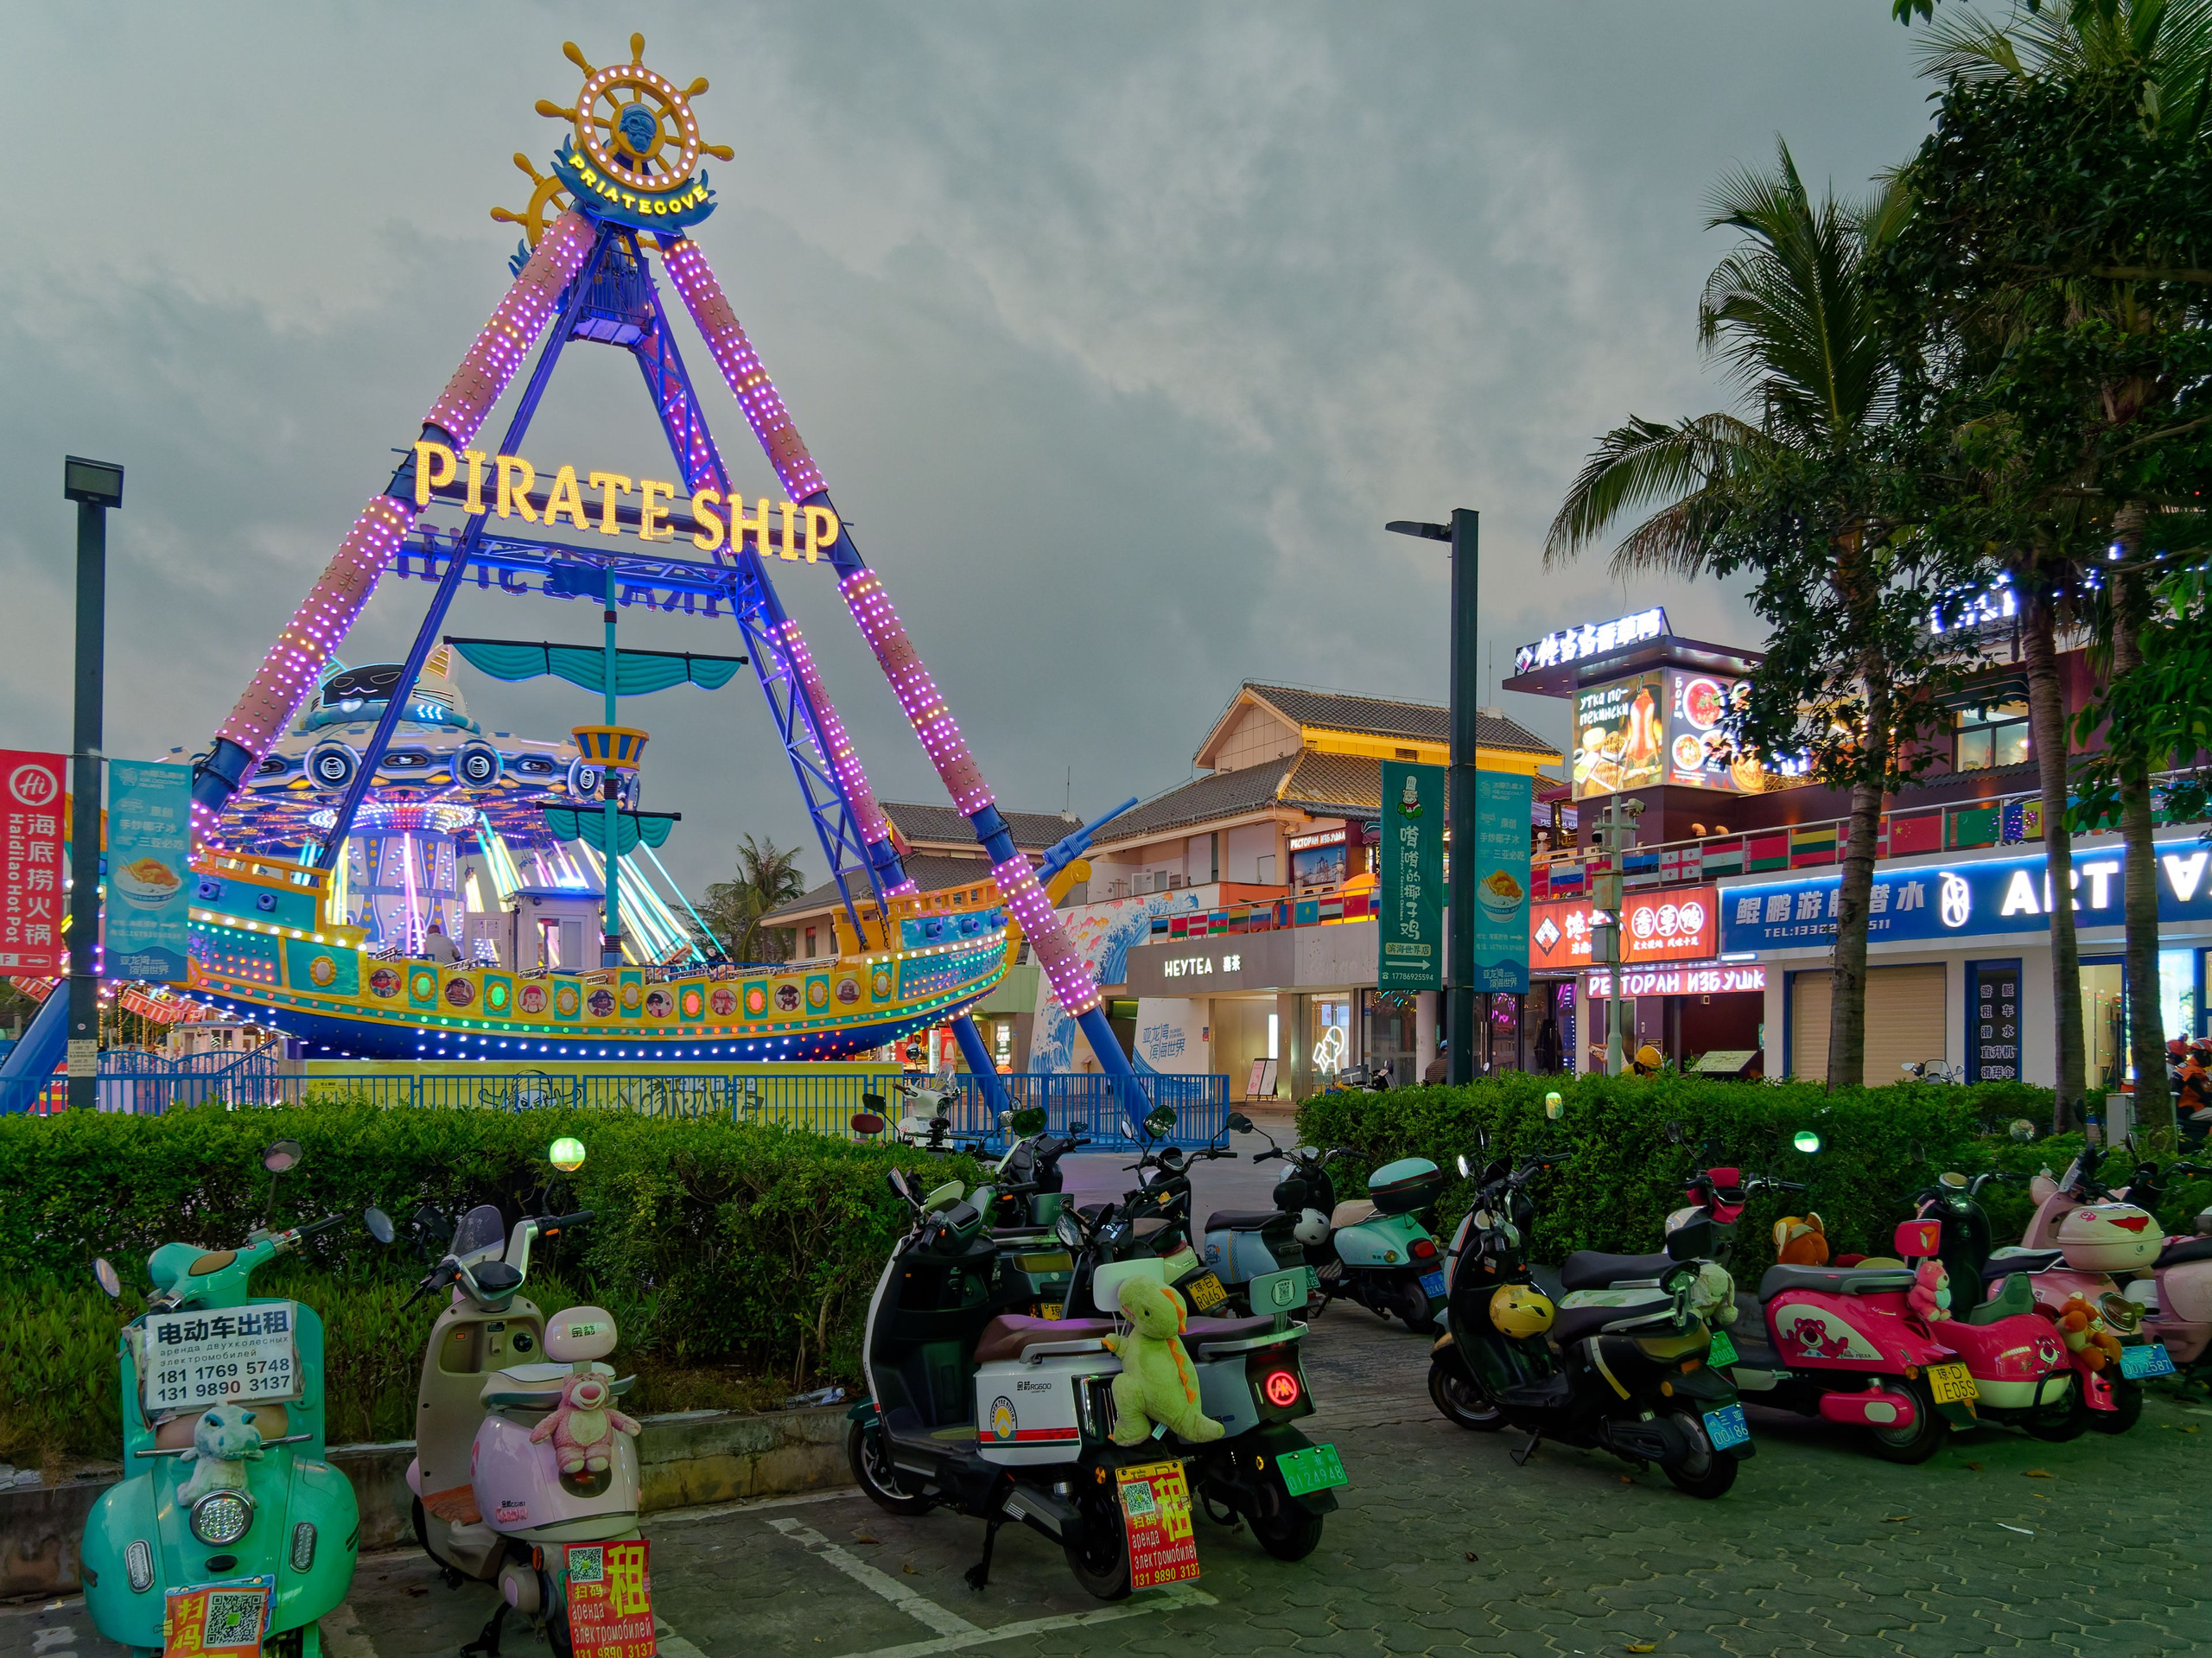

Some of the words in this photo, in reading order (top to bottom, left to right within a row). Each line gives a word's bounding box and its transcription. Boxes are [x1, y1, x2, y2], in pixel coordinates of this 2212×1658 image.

[569, 154, 709, 215] PRIATECOVE
[414, 441, 676, 543] PIRATE
[691, 488, 840, 564] SHIP
[20, 772, 48, 796] Hi
[8, 813, 25, 881] Haidilao
[1290, 835, 1319, 849] РЕСТОРАН
[24, 813, 57, 946] 海底捞火锅
[6, 885, 22, 912] Hot
[5, 916, 20, 943] Pot
[1387, 944, 1431, 955] 滨海世界店
[1165, 957, 1212, 977] HEYTEA
[1223, 955, 1241, 972] 喜茶
[1392, 973, 1433, 981] 17786925594
[1588, 973, 1680, 995] РЕТОРАН
[1142, 1023, 1169, 1044] 亚龙湾
[1149, 1038, 1185, 1061] 滨海世界
[1980, 1045, 2014, 1058] 直升机
[1980, 1066, 2014, 1079] 滑翔伞
[157, 1310, 289, 1345] 电动车出租
[161, 1345, 200, 1357] аренда
[207, 1336, 289, 1350] двухколесных
[157, 1369, 187, 1384] 181
[195, 1363, 238, 1380] 1769
[246, 1358, 289, 1375] 5748
[2125, 1359, 2170, 1375] 0012587
[157, 1386, 188, 1401] 131
[196, 1381, 241, 1397] 9890
[249, 1375, 290, 1392] 3137
[1287, 1464, 1344, 1491] 0124948
[1133, 1513, 1157, 1529] 扫码
[1152, 1476, 1194, 1543] 租
[1132, 1529, 1160, 1553] аренда
[607, 1543, 650, 1618] 租
[1135, 1572, 1150, 1586] 131
[1154, 1567, 1177, 1584] 9890
[1180, 1562, 1200, 1579] 3137
[575, 1584, 603, 1600] 扫码
[171, 1596, 205, 1651] 扫码
[572, 1603, 605, 1624] аренда
[574, 1617, 652, 1646] электромобилей
[627, 1641, 653, 1658] 3137
